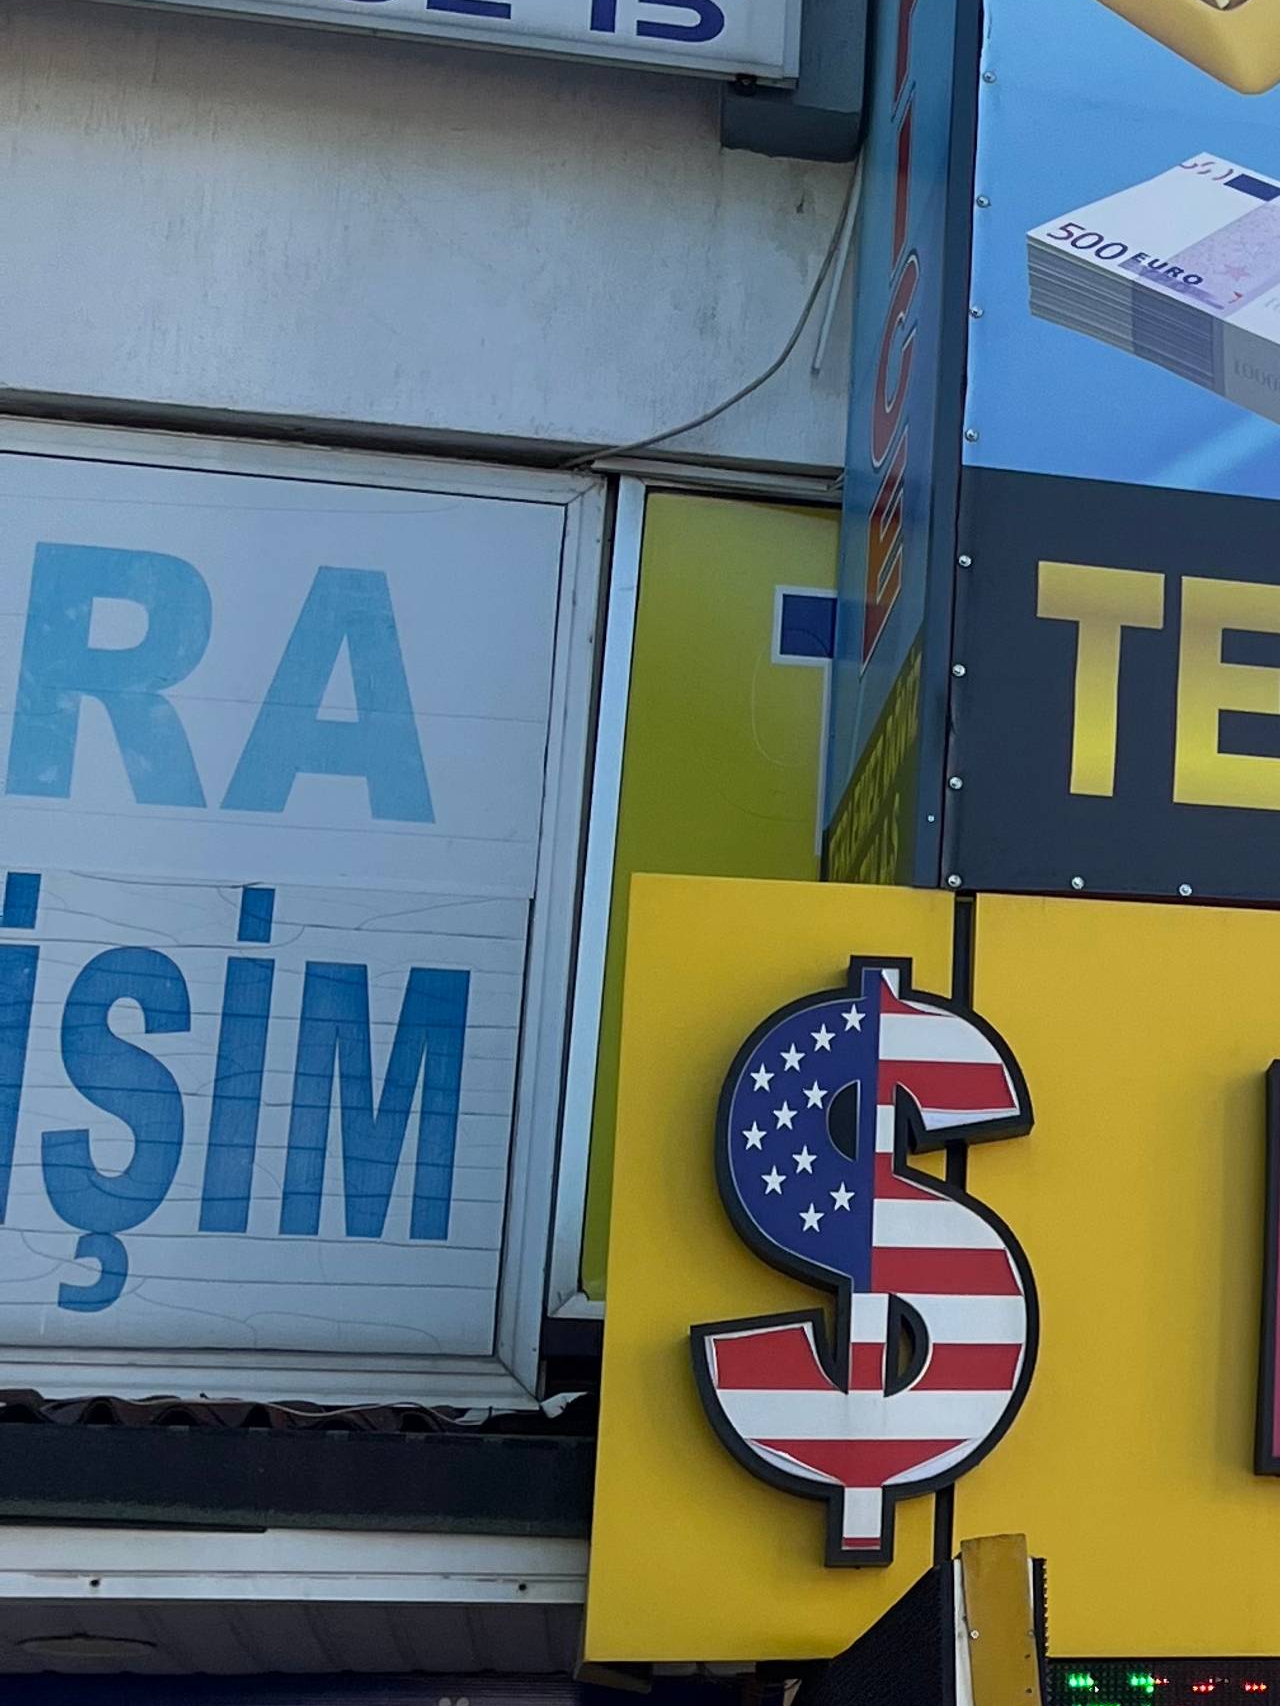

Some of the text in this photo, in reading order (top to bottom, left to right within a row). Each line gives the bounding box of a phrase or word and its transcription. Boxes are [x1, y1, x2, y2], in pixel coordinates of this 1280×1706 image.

[1046, 223, 1203, 287] 500 EURO
[5, 542, 436, 824] RA
